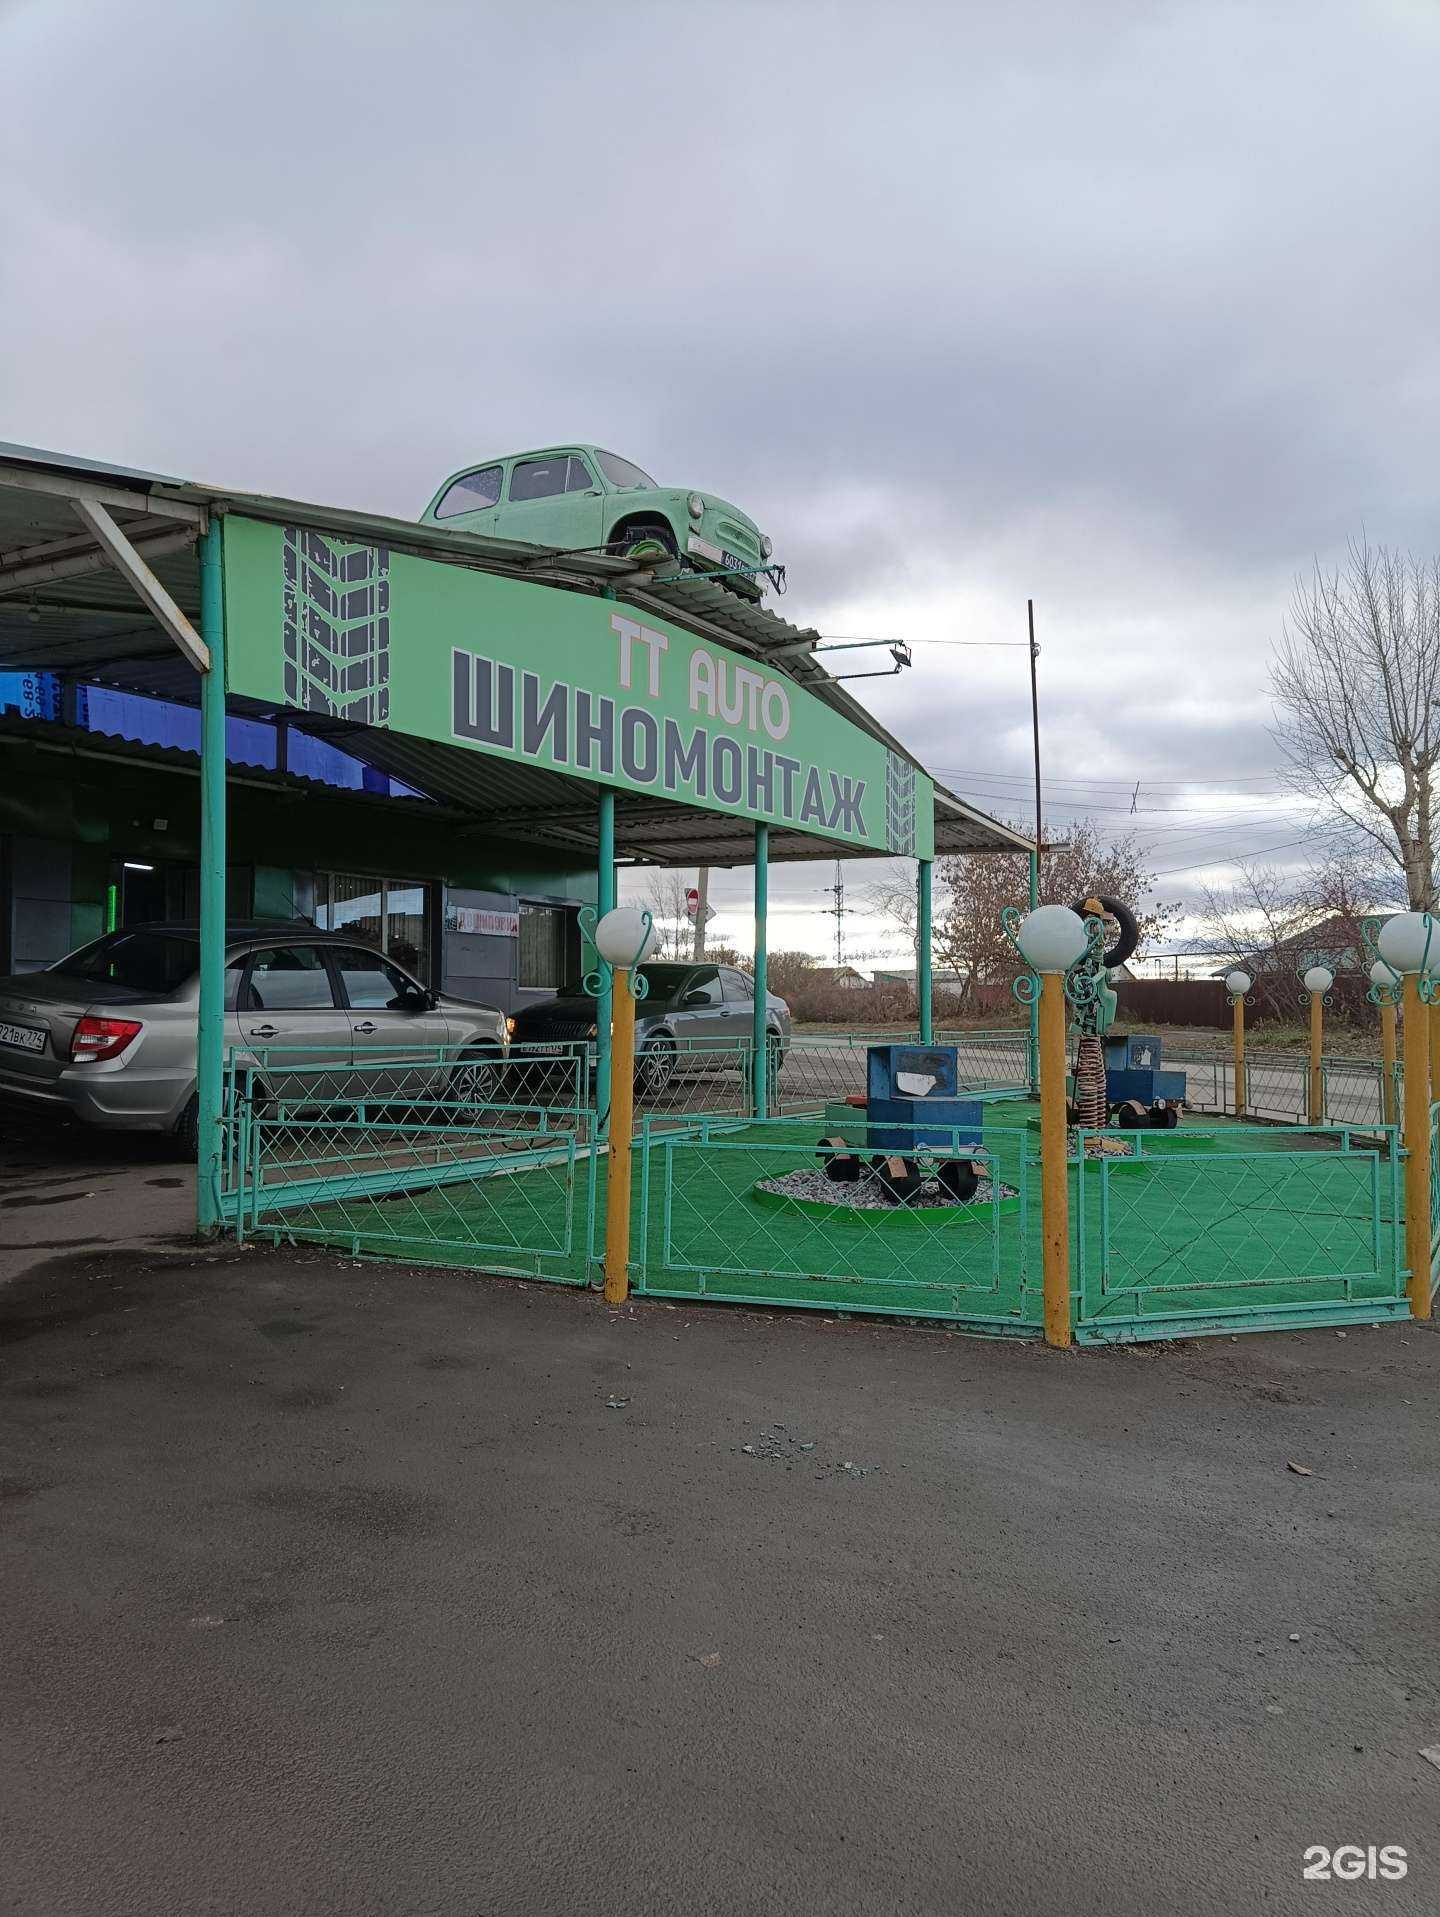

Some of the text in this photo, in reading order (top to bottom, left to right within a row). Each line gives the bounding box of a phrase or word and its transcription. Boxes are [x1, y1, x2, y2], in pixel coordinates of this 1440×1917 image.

[450, 646, 868, 838] ШИНОМОНТАЖ
[610, 612, 791, 741] TT AUTO
